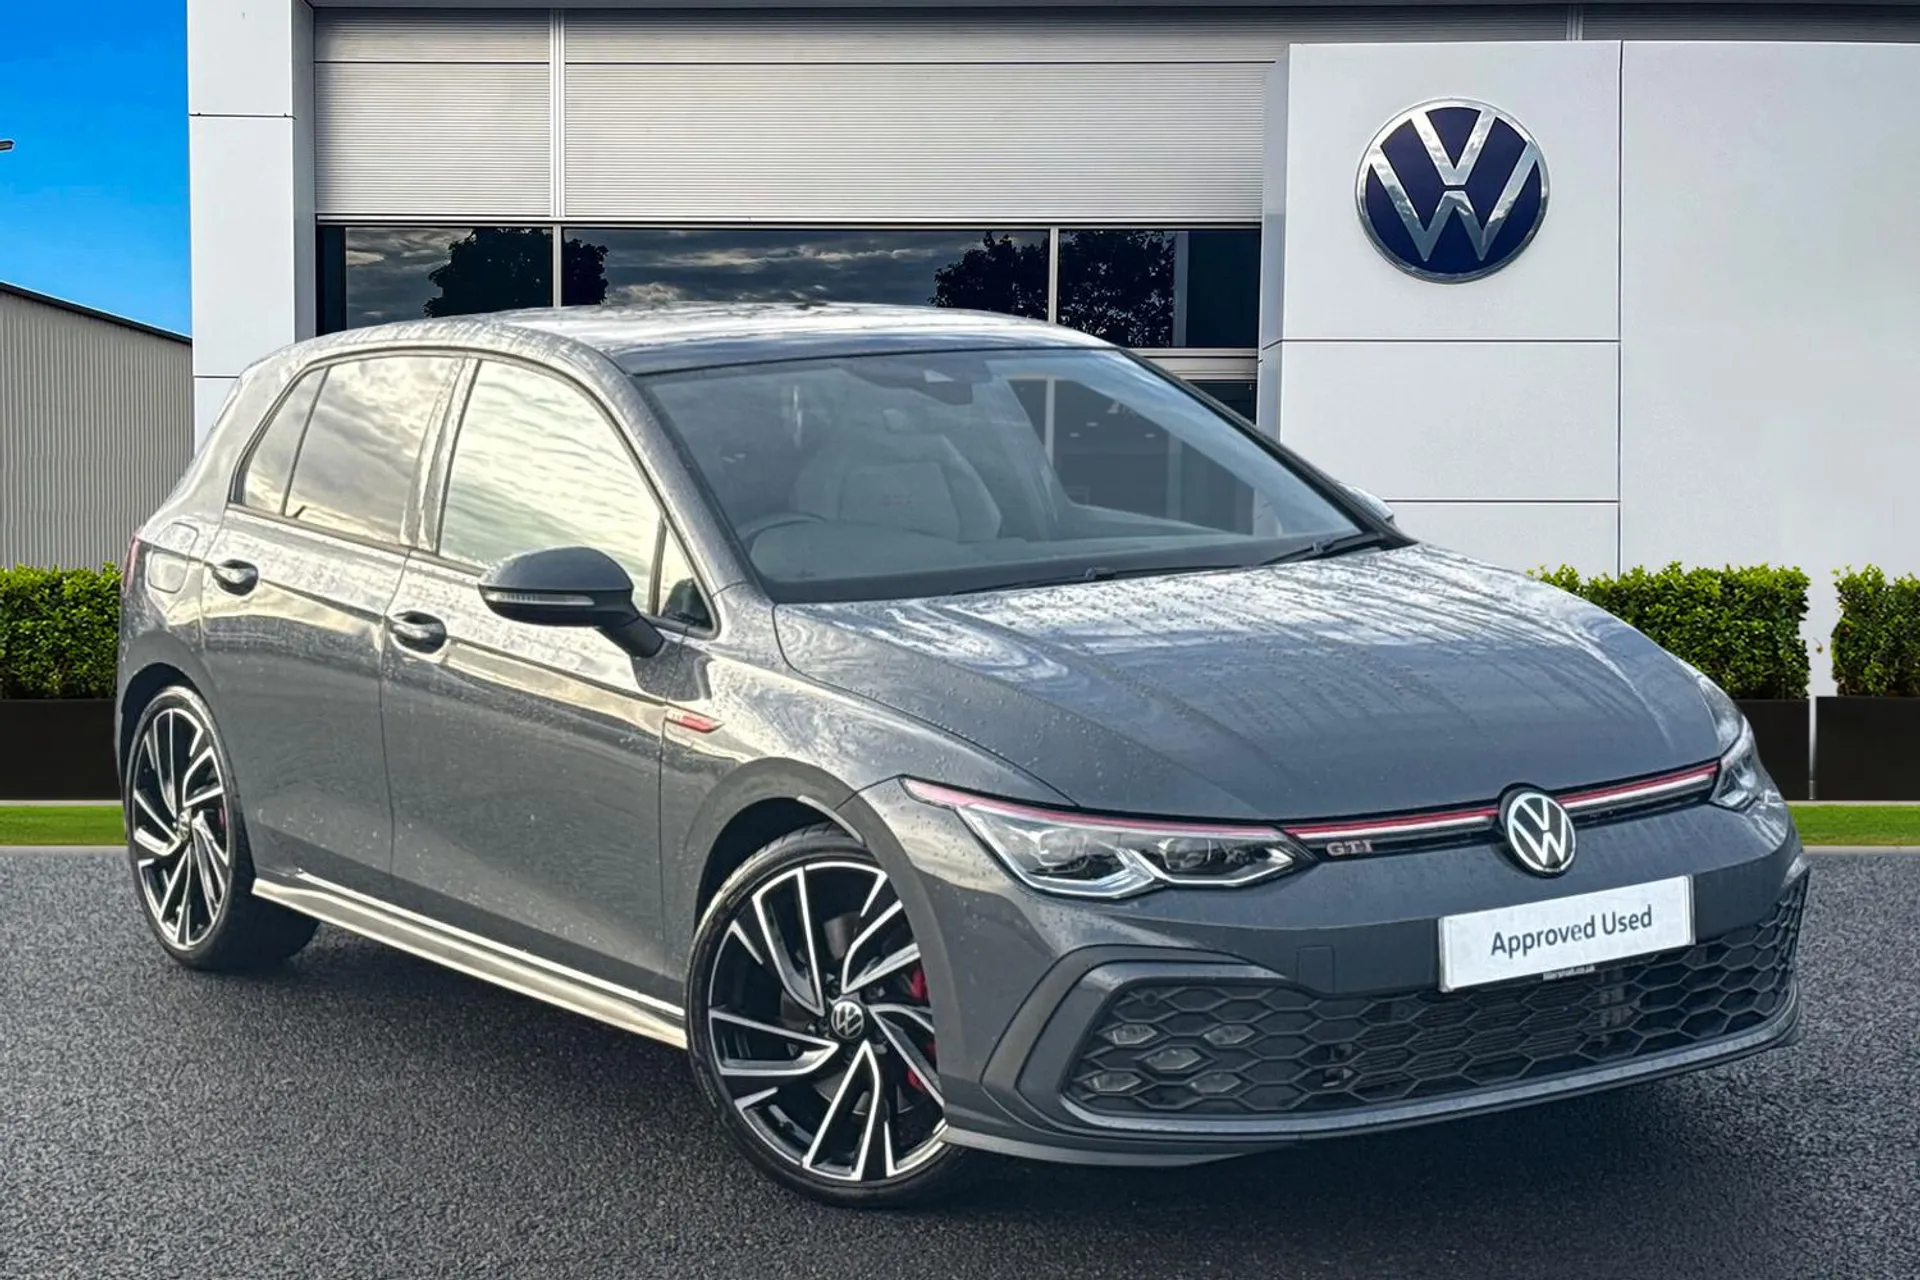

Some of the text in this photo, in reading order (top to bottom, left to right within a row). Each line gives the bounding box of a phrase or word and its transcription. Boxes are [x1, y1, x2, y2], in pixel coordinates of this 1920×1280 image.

[1361, 104, 1542, 265] VW
[1326, 839, 1374, 857] GTI
[1510, 795, 1570, 867] VW
[1490, 903, 1653, 959] Approved Used
